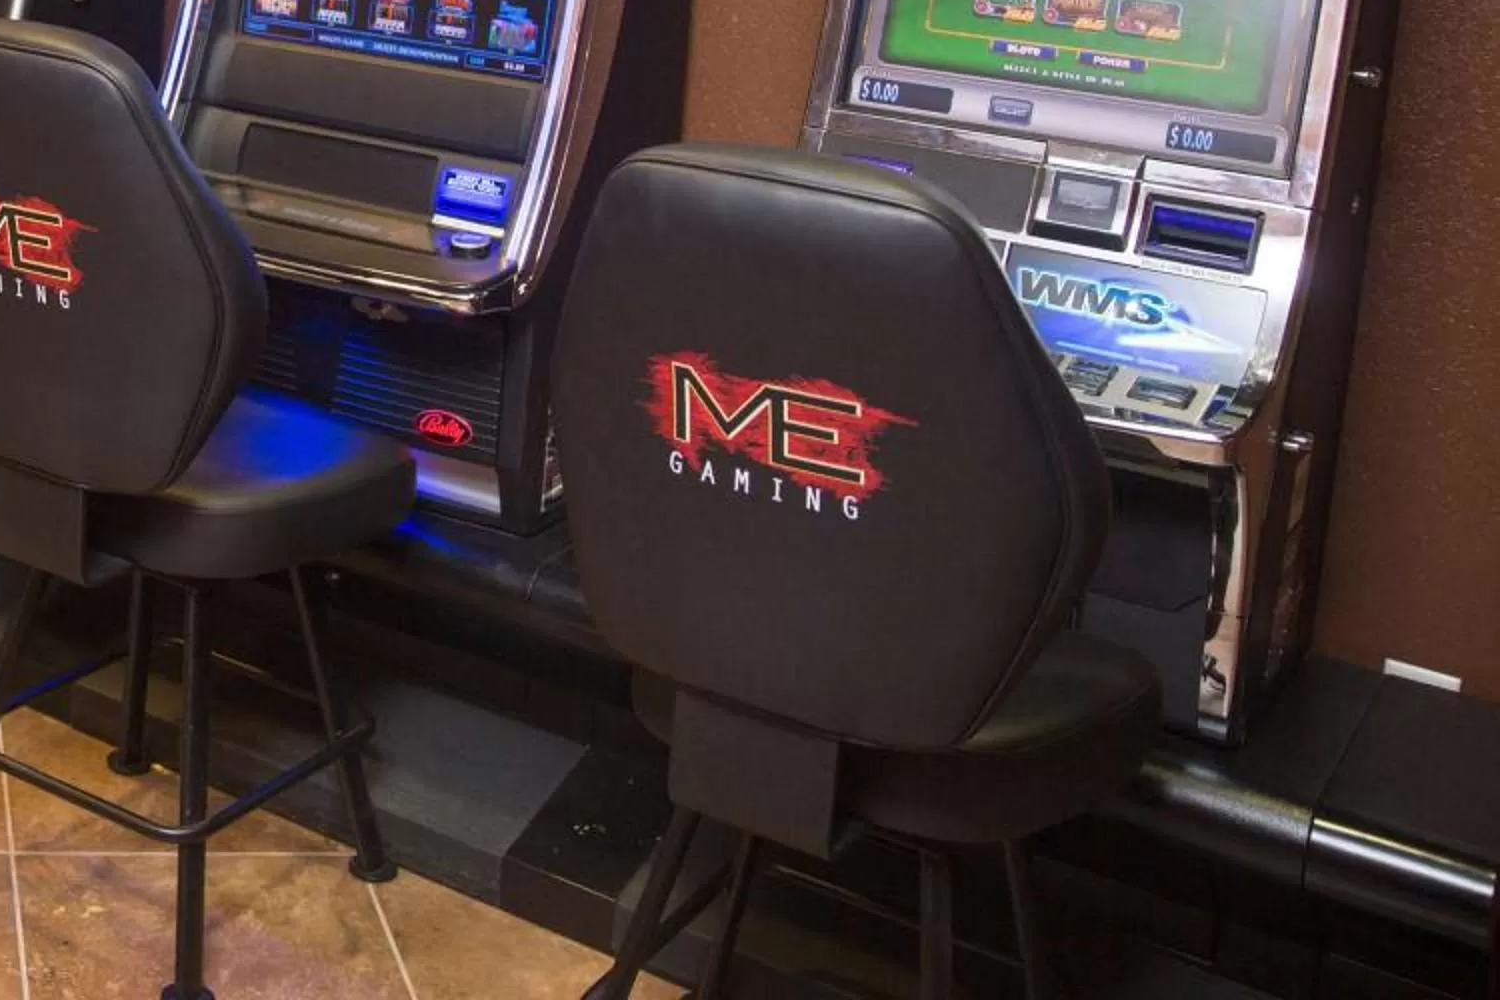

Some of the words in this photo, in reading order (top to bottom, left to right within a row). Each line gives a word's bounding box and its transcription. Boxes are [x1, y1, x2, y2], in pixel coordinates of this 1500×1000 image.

[1092, 54, 1131, 69] POKER
[1017, 267, 1169, 328] WMS
[671, 360, 866, 486] ME
[668, 450, 860, 520] GAMING
